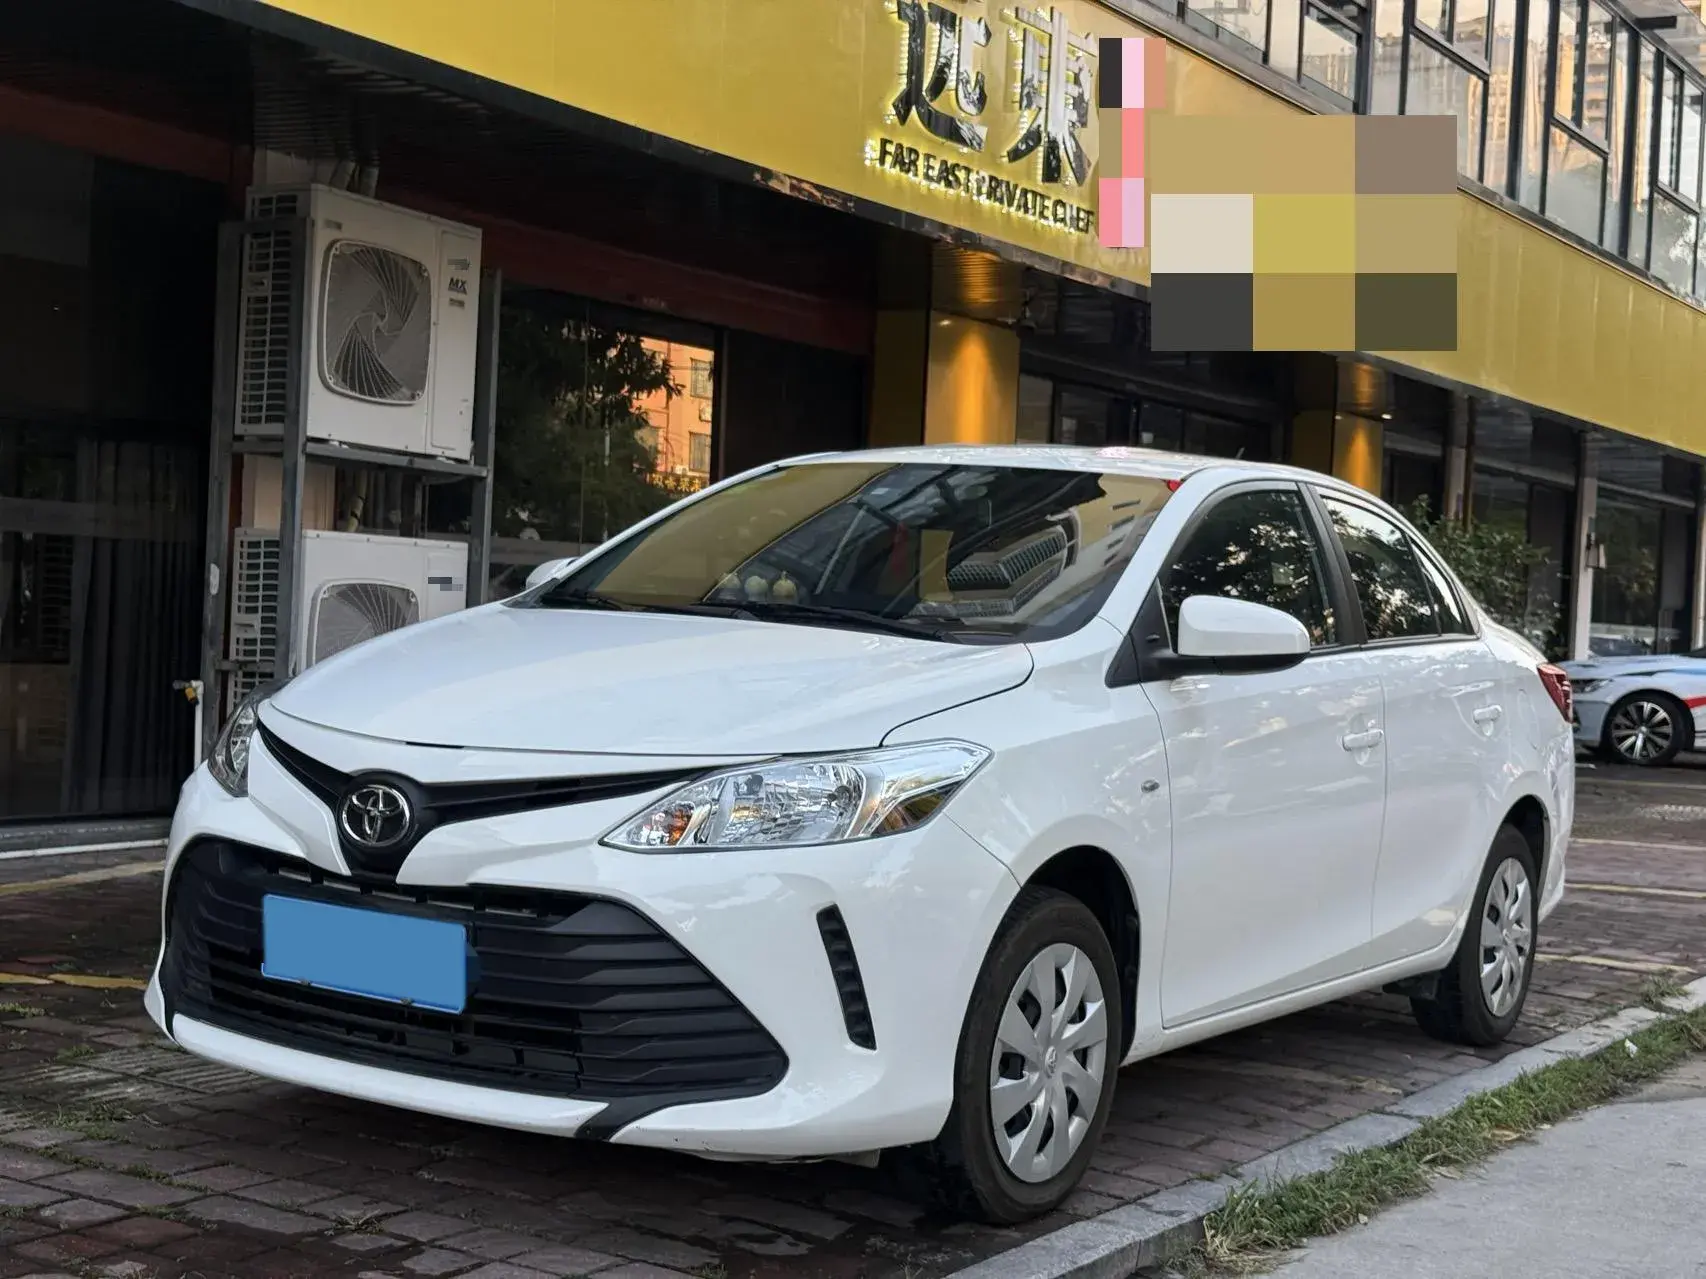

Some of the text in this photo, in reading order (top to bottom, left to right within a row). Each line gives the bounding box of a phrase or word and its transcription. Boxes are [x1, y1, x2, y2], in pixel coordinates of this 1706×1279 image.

[879, 137, 1095, 234] FAR EAST PRIVATE CHEF
